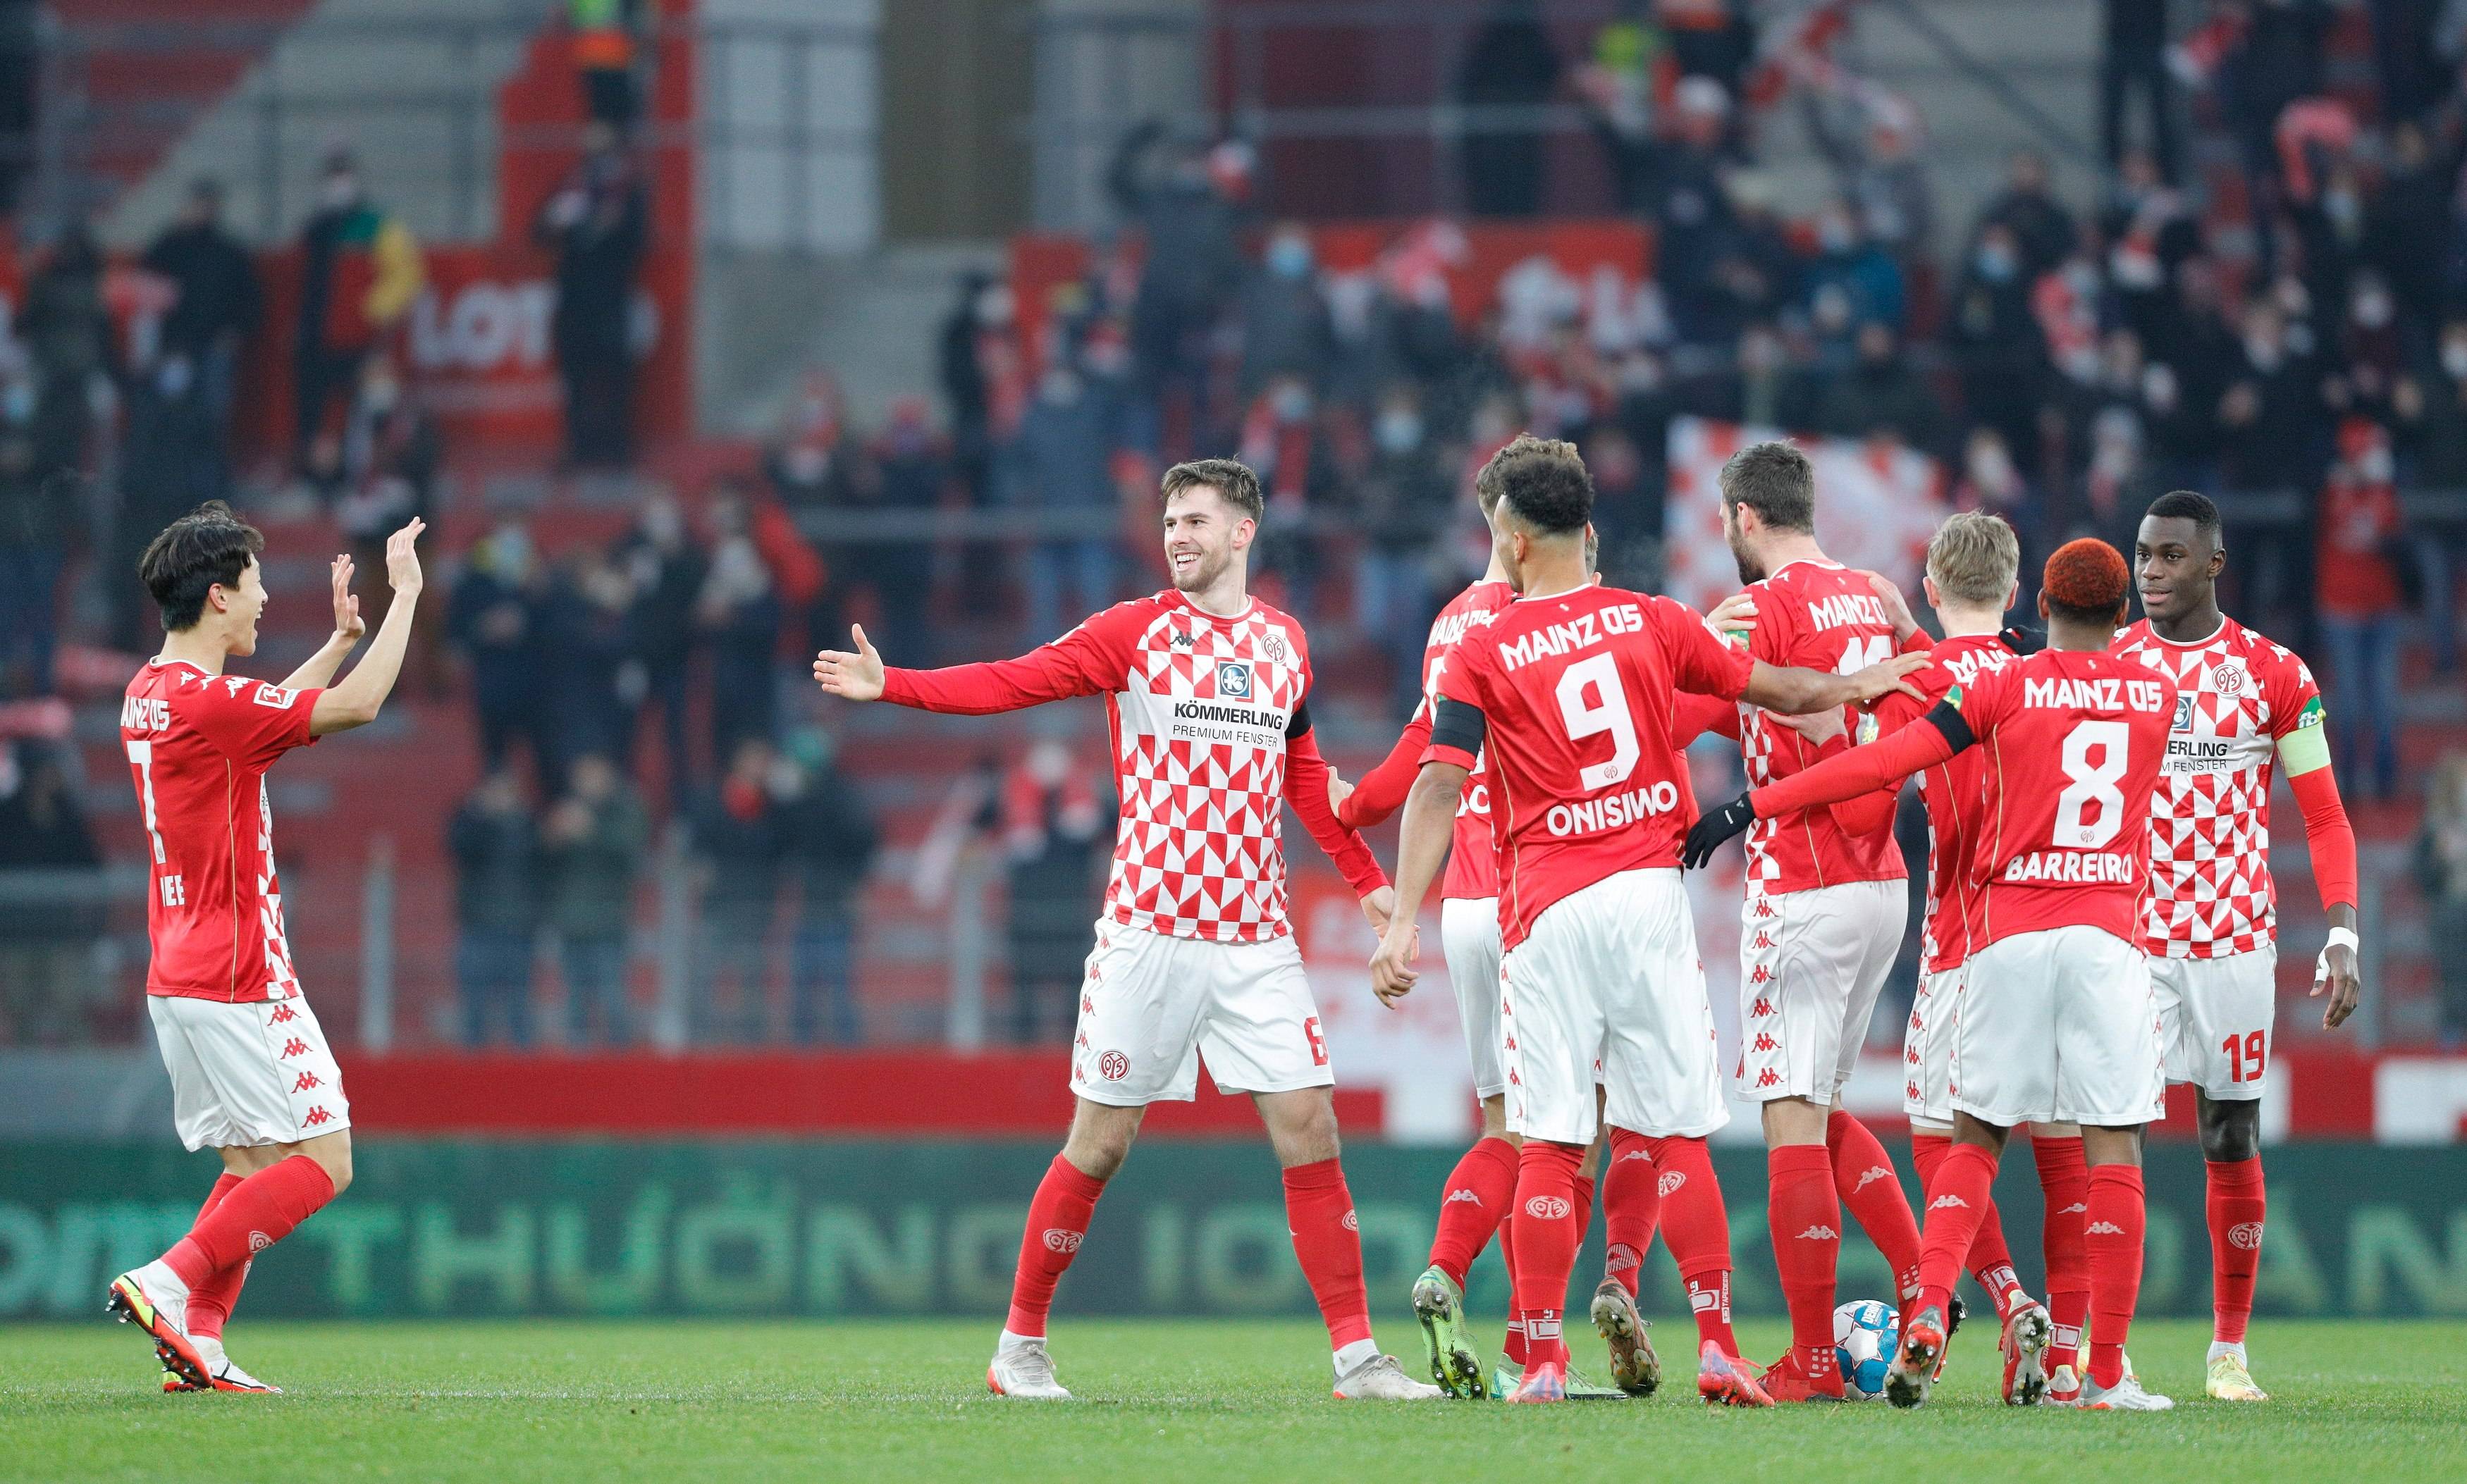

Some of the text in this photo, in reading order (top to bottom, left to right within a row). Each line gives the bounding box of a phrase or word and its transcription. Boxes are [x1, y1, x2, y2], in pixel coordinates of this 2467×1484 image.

[1808, 594, 1889, 631] MAINZ 0
[1499, 604, 1643, 672] MAINZ 05
[121, 695, 170, 731] AINZ 05
[2024, 677, 2162, 713] MAINZ 05
[1174, 700, 1283, 730] KÖMMERLING
[1555, 651, 1641, 791] 9
[1173, 724, 1278, 748] PREMIUM FENSTER
[2165, 740, 2228, 756] ERLING
[2053, 719, 2129, 848] 8
[2174, 759, 2227, 772] FENSTER
[127, 741, 166, 864] 7
[1546, 780, 1678, 836] ONISIWO
[2005, 851, 2132, 884] BARREIRO
[1303, 1016, 1329, 1065] 6
[2222, 1029, 2265, 1083] 19
